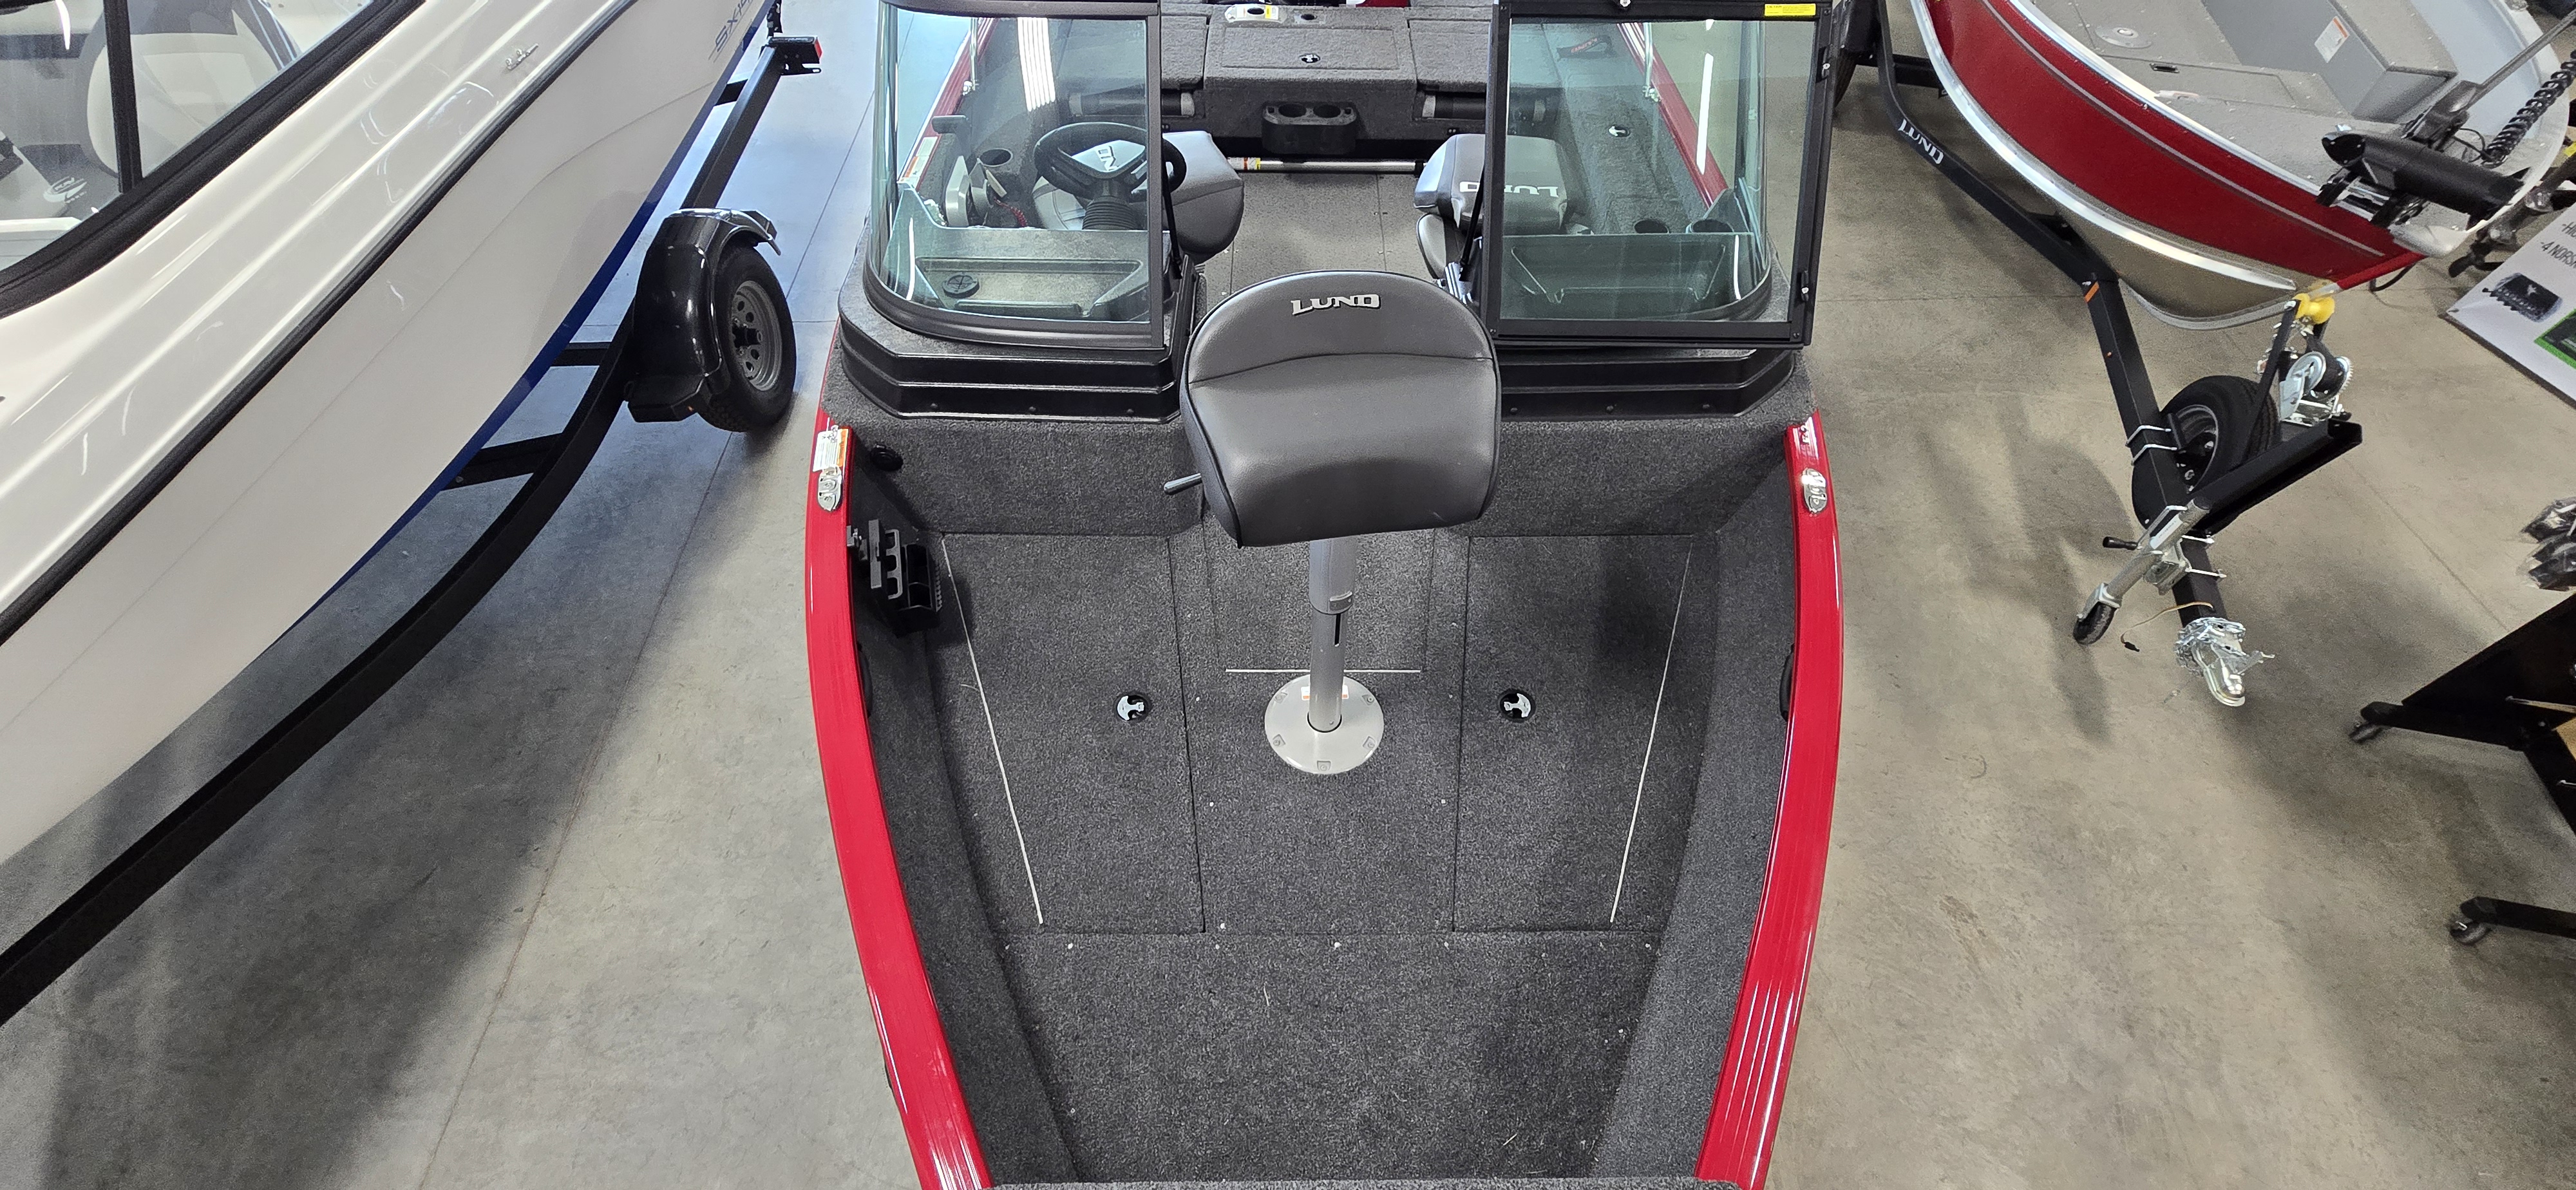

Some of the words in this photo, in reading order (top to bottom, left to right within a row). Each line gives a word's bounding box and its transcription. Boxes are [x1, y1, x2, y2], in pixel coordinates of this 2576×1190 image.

[1897, 118, 1944, 164] LUND
[1459, 181, 1559, 198] LUD
[1290, 294, 1380, 316] LUND
